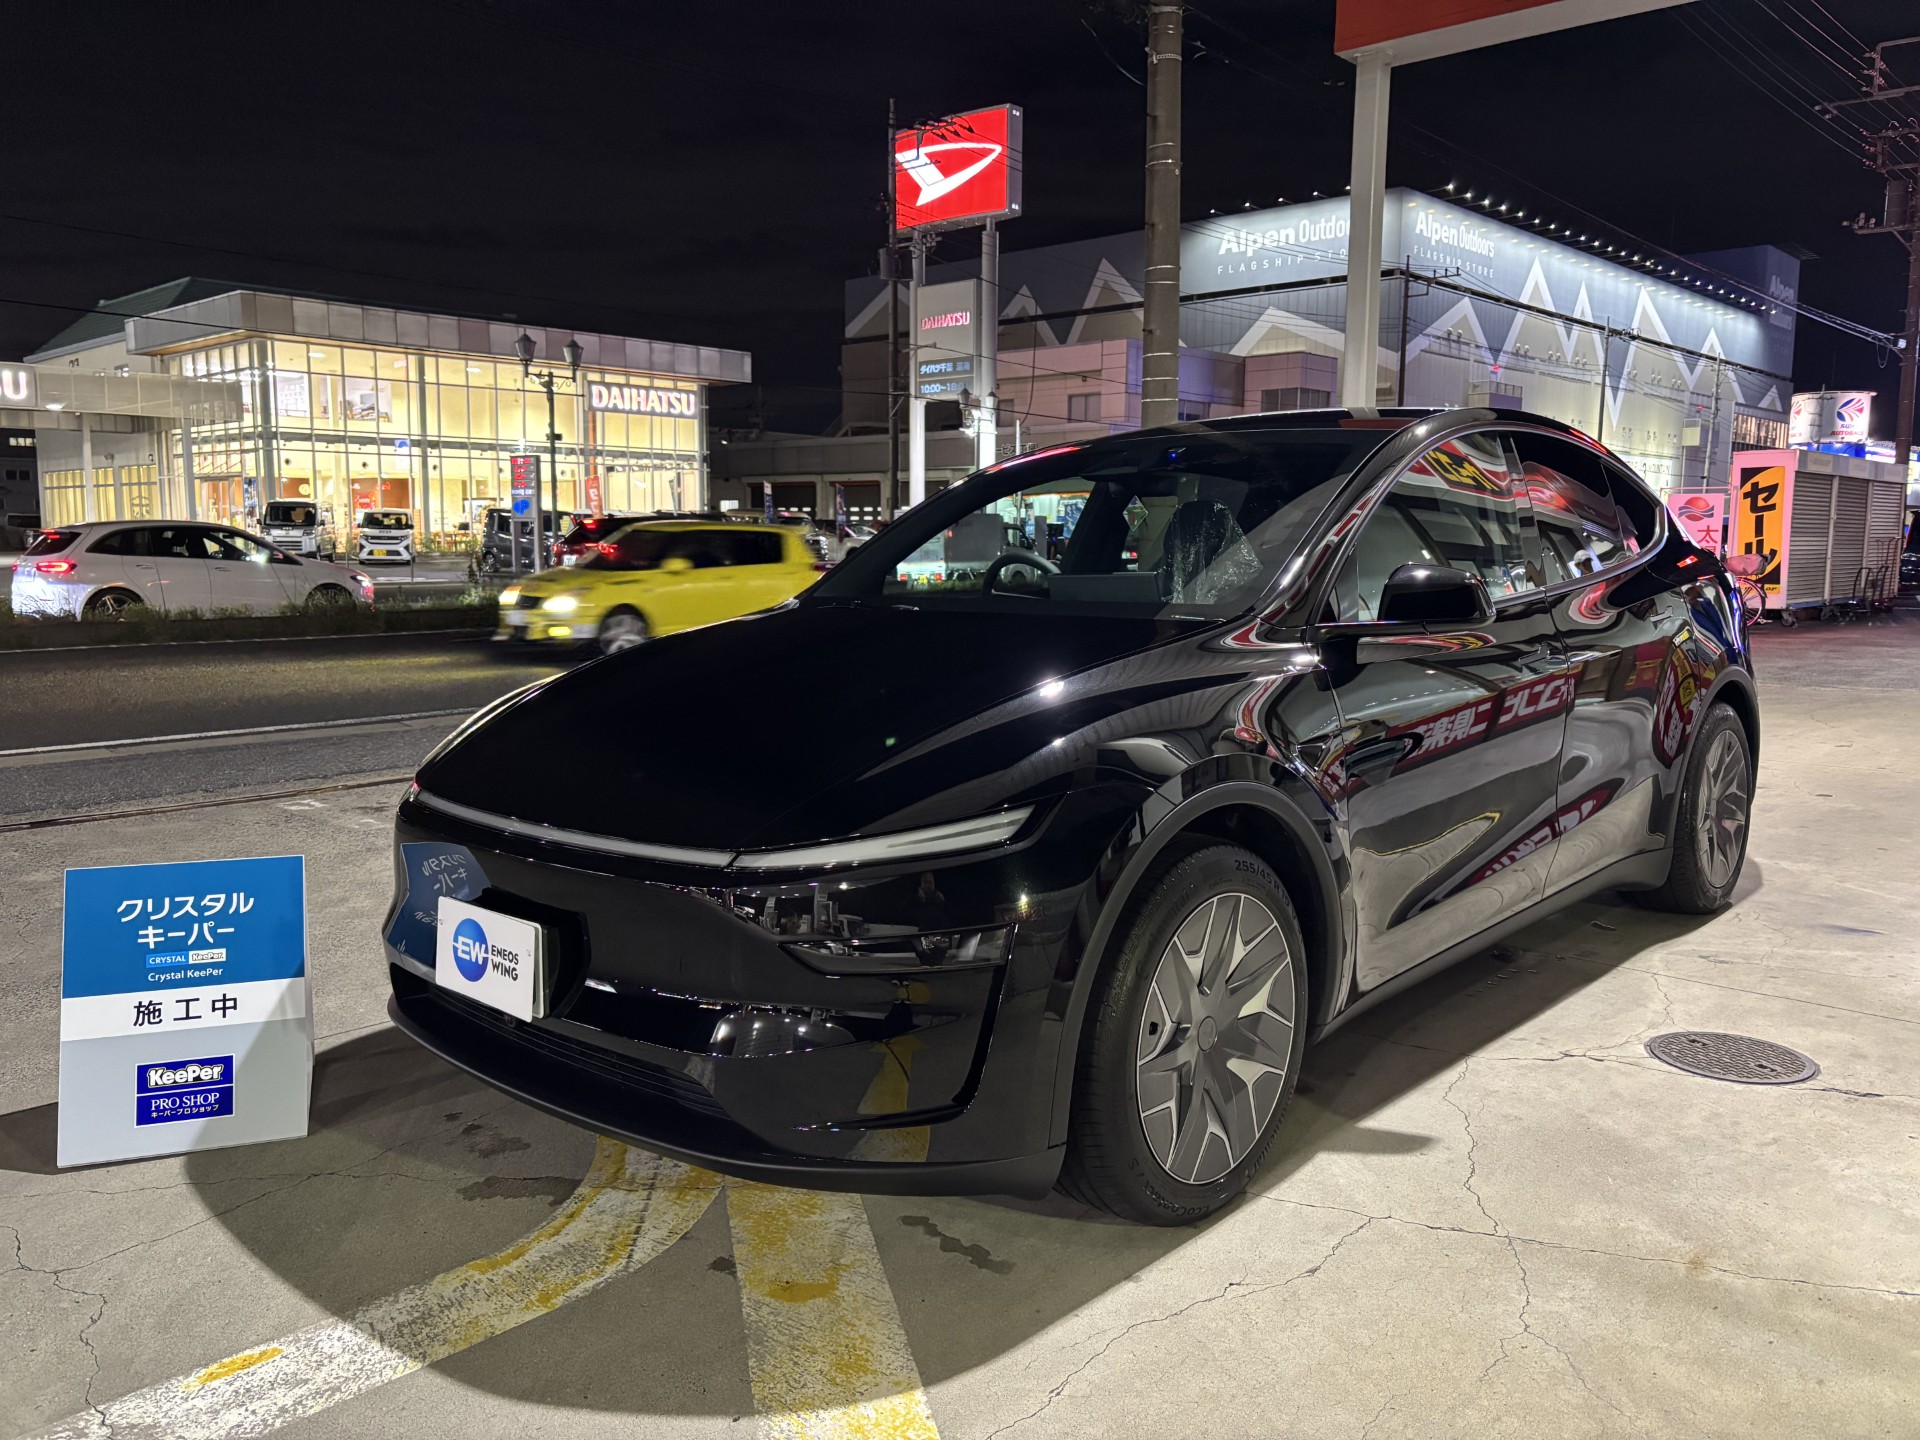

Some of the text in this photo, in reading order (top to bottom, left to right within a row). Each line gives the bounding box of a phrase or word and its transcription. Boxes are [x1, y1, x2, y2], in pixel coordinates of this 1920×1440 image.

[1218, 227, 1296, 257] Alpen
[1415, 210, 1495, 258] Alpen Outdoors
[1217, 254, 1303, 275] FLAGSHIP
[1414, 245, 1494, 279] FLAGSHIP STORE
[921, 311, 970, 330] DAIHATSU
[0, 370, 28, 400] U
[592, 384, 696, 416] DAIHATSU
[1234, 859, 1273, 885] 255/45
[117, 891, 255, 923] クリスタル
[137, 920, 235, 949] キーパー
[149, 955, 187, 965] CRYSTAL
[491, 944, 519, 966] ENEOS
[148, 967, 223, 983] Crystal KeePer
[491, 958, 519, 982] WING
[133, 993, 238, 1027] 施工中
[147, 1064, 224, 1088] KeePer
[151, 1092, 220, 1111] PRO SHOP
[151, 1104, 219, 1118] キーパープロショップ
